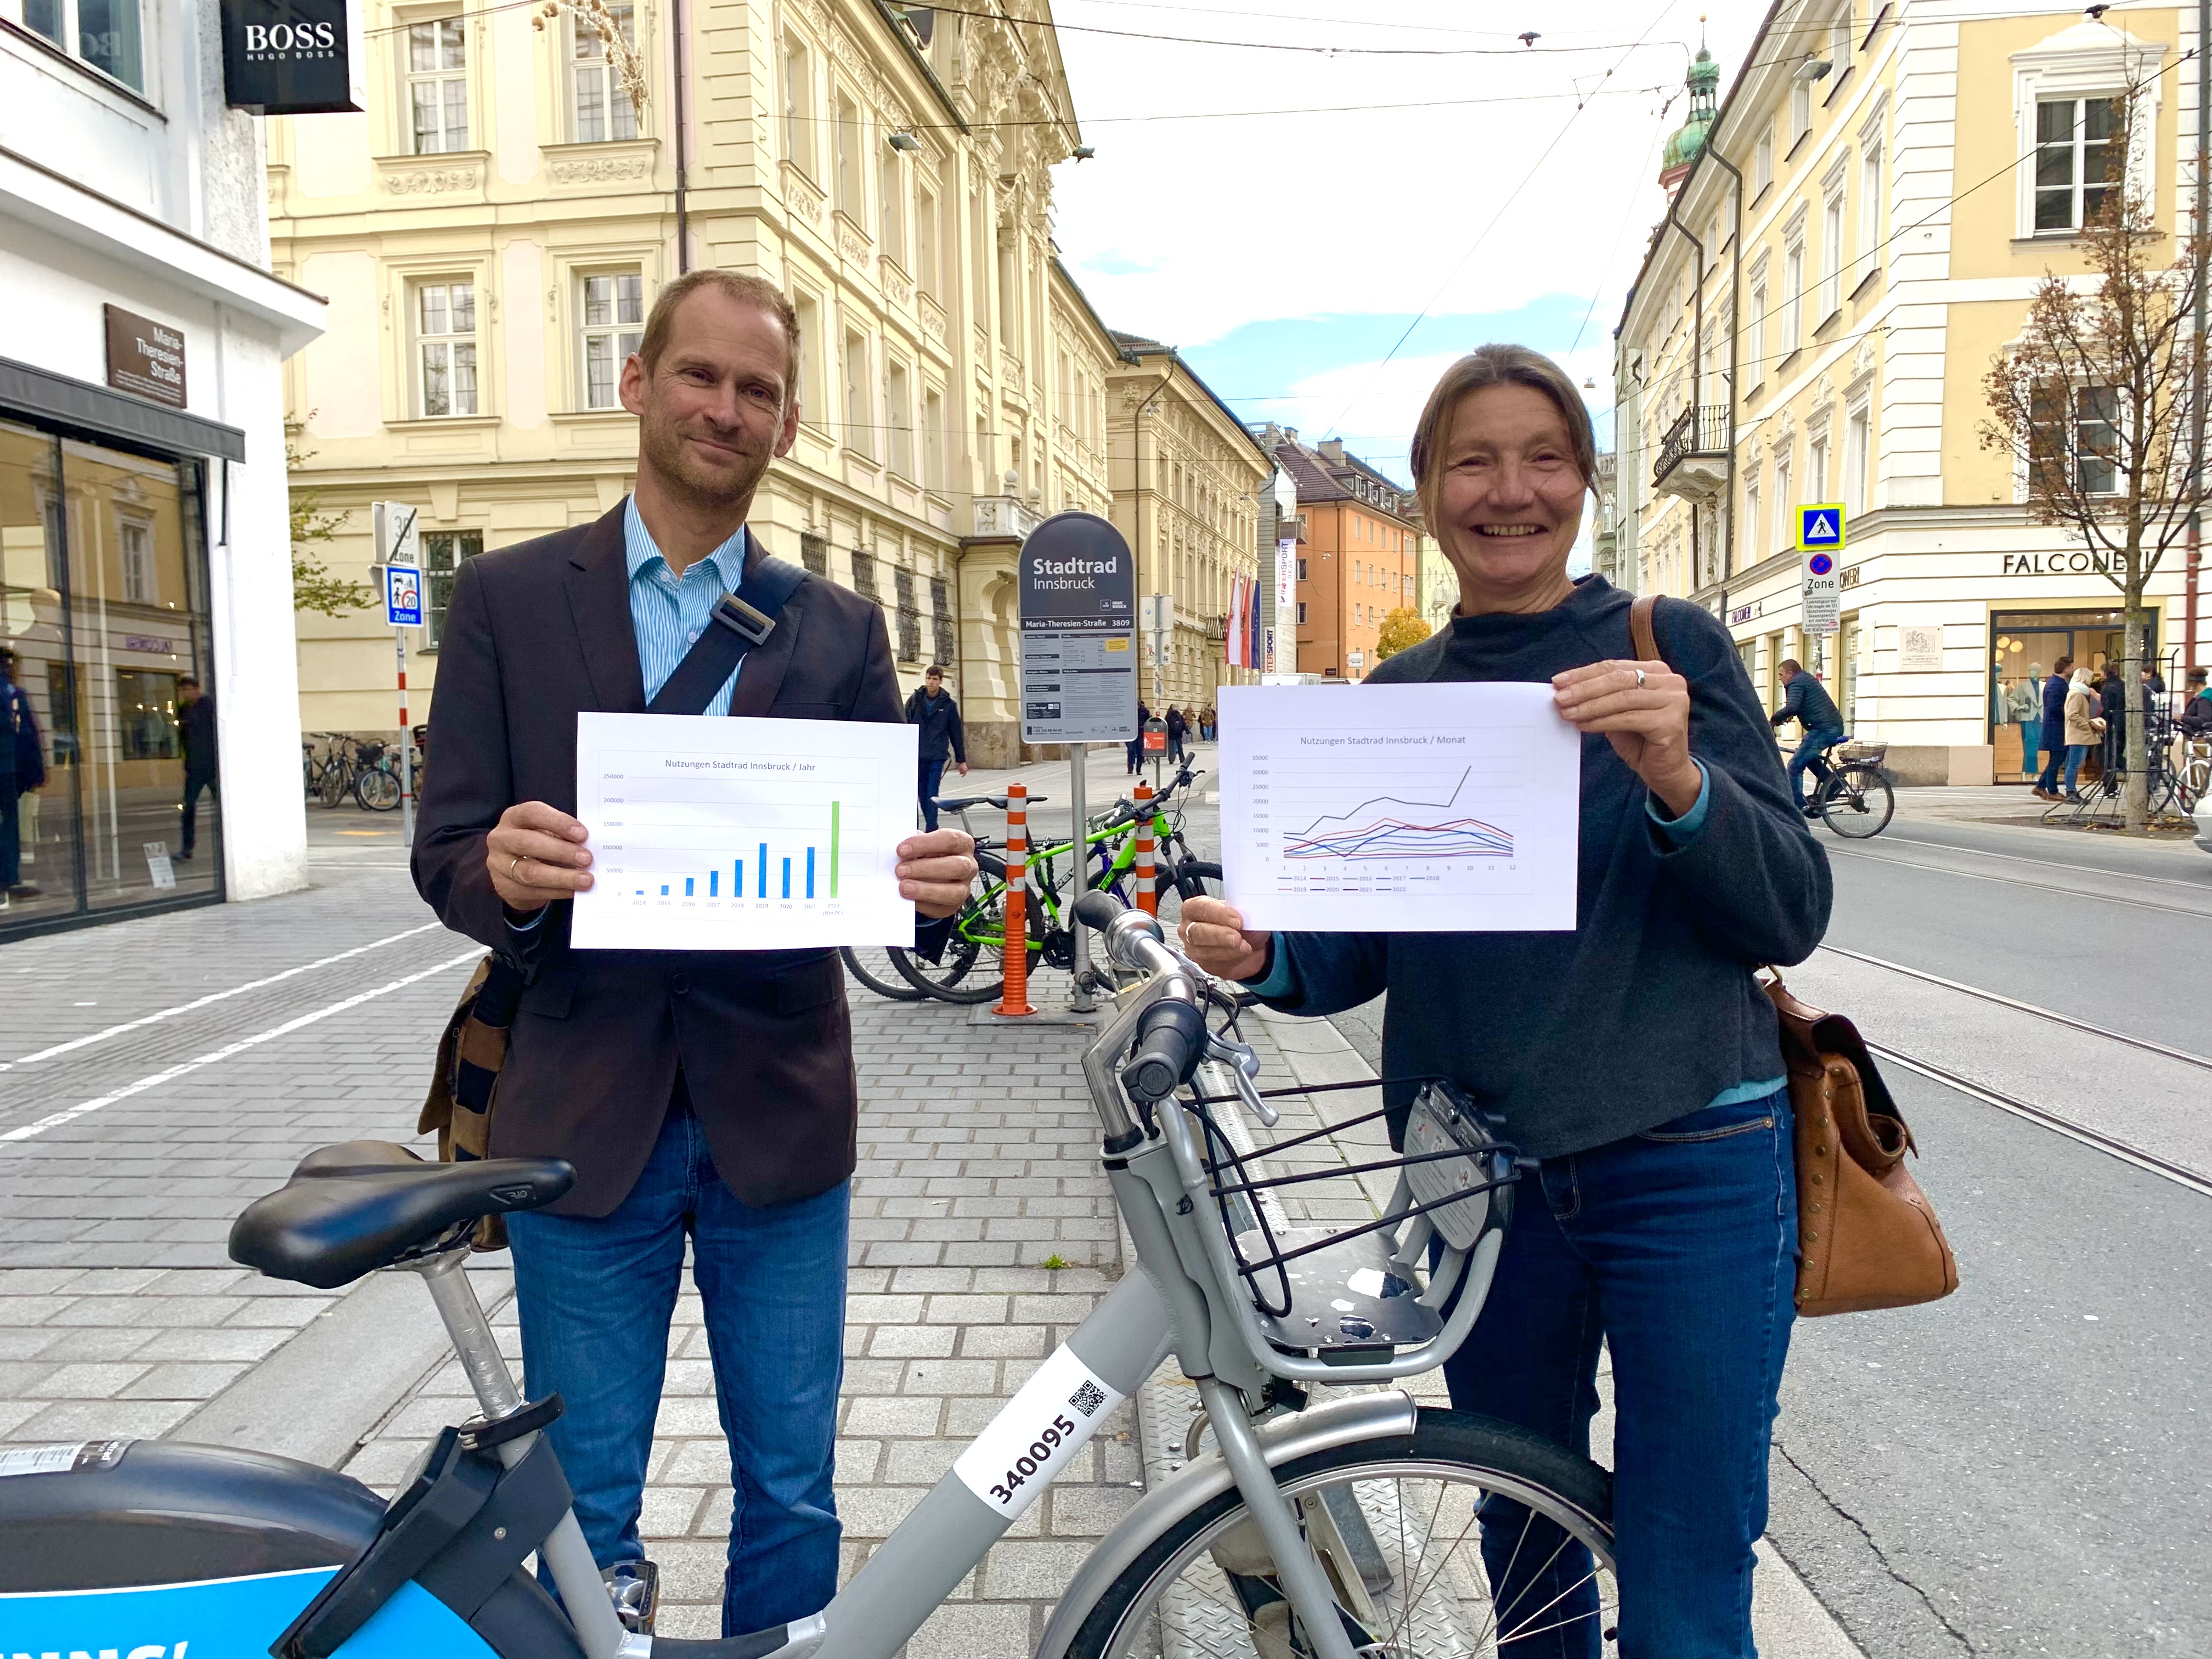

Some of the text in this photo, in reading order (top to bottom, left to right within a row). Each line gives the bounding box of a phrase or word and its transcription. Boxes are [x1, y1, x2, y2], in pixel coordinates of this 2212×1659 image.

[246, 22, 335, 51] BOSS
[247, 50, 334, 61] HUGO BOSS
[153, 326, 183, 350] Maria-
[136, 337, 184, 368] Theresien-
[150, 360, 182, 385] Straße
[394, 515, 411, 539] 30
[1033, 556, 1117, 575] Stadtrad
[2004, 551, 2149, 574] FALCONEI
[1034, 577, 1096, 590] Innsbruck
[1808, 579, 1834, 589] Zone
[407, 596, 416, 607] 20
[394, 610, 416, 622] Zone
[1025, 619, 1107, 628] Maria-Theresien-Straße
[1300, 737, 1345, 746] Nutzungen
[1347, 736, 1383, 744] Stadtrad
[1386, 736, 1427, 744] Innsbruck
[1430, 736, 1435, 745] /
[665, 760, 710, 770] Nutzungen
[713, 761, 748, 769] Stadtrad
[751, 762, 790, 770] Innsbruck
[792, 763, 797, 771] /
[989, 1414, 1075, 1504] 340095
